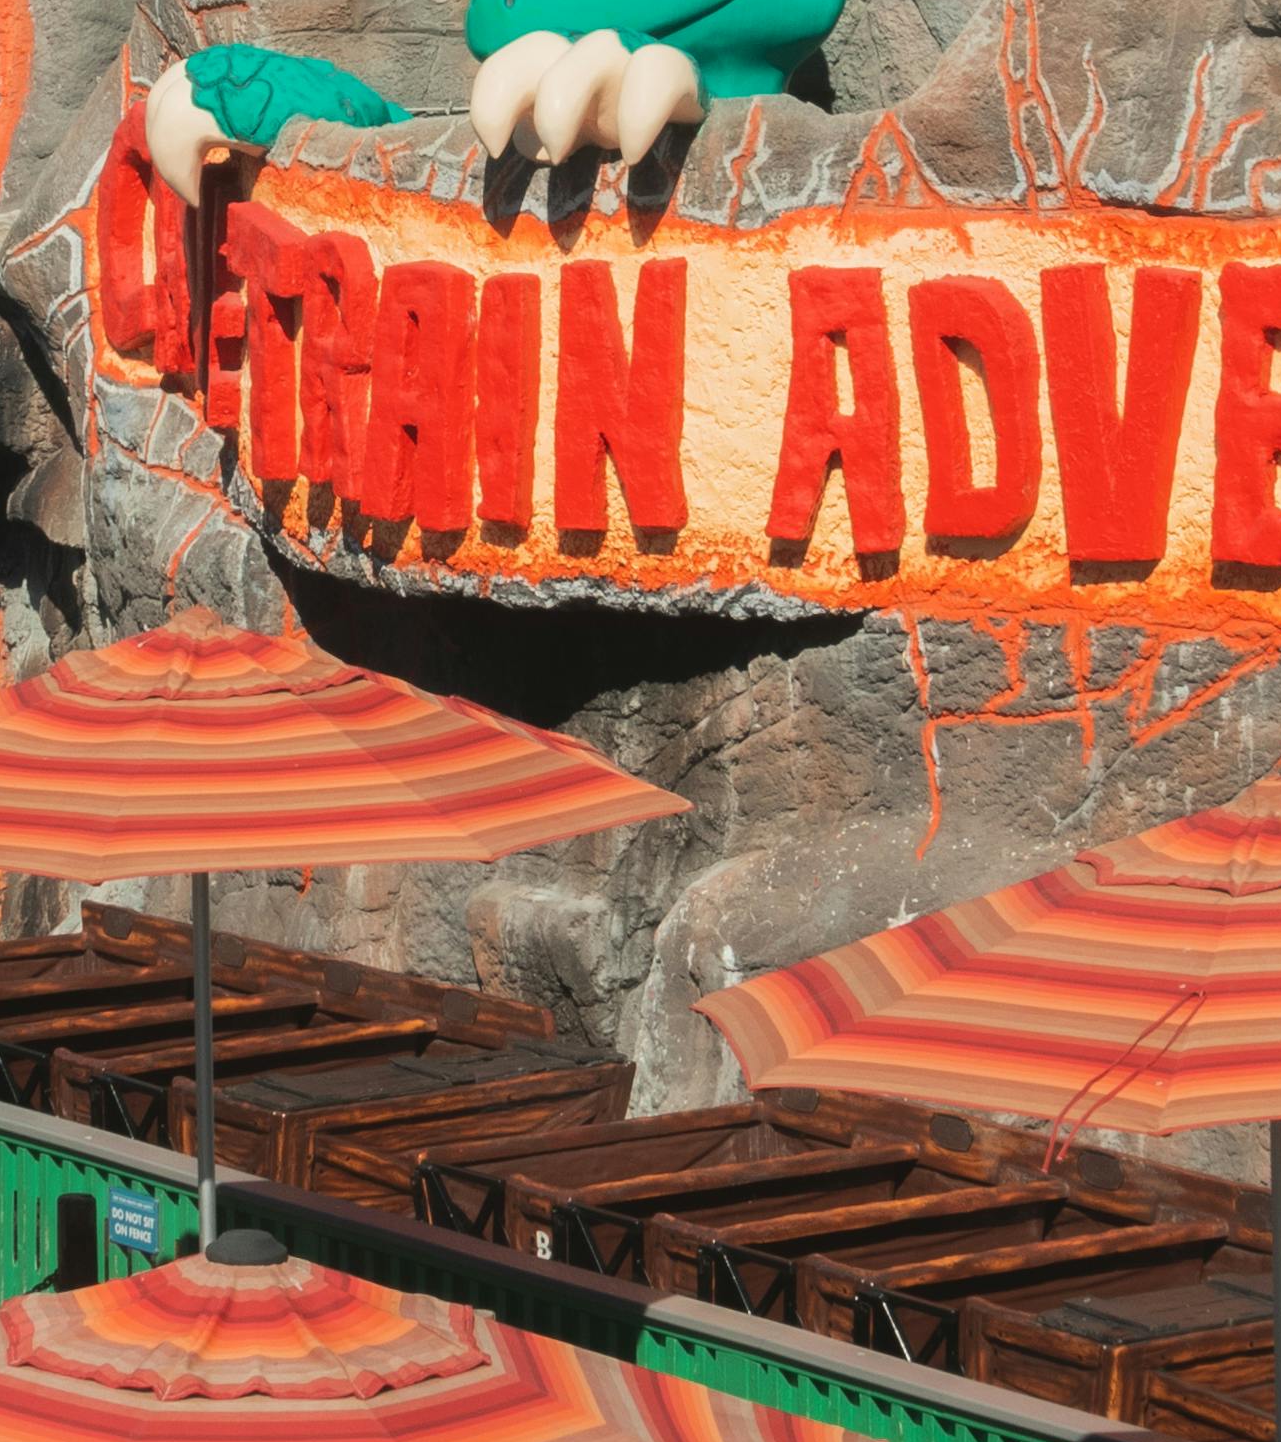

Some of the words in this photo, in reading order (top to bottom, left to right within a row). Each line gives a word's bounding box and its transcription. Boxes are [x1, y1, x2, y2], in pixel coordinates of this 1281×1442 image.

[111, 1207, 124, 1221] DO
[125, 1210, 142, 1226] NOT
[143, 1216, 155, 1229] SIT
[114, 1222, 128, 1237] ON
[128, 1226, 152, 1244] FENCE
[536, 1230, 552, 1260] B
